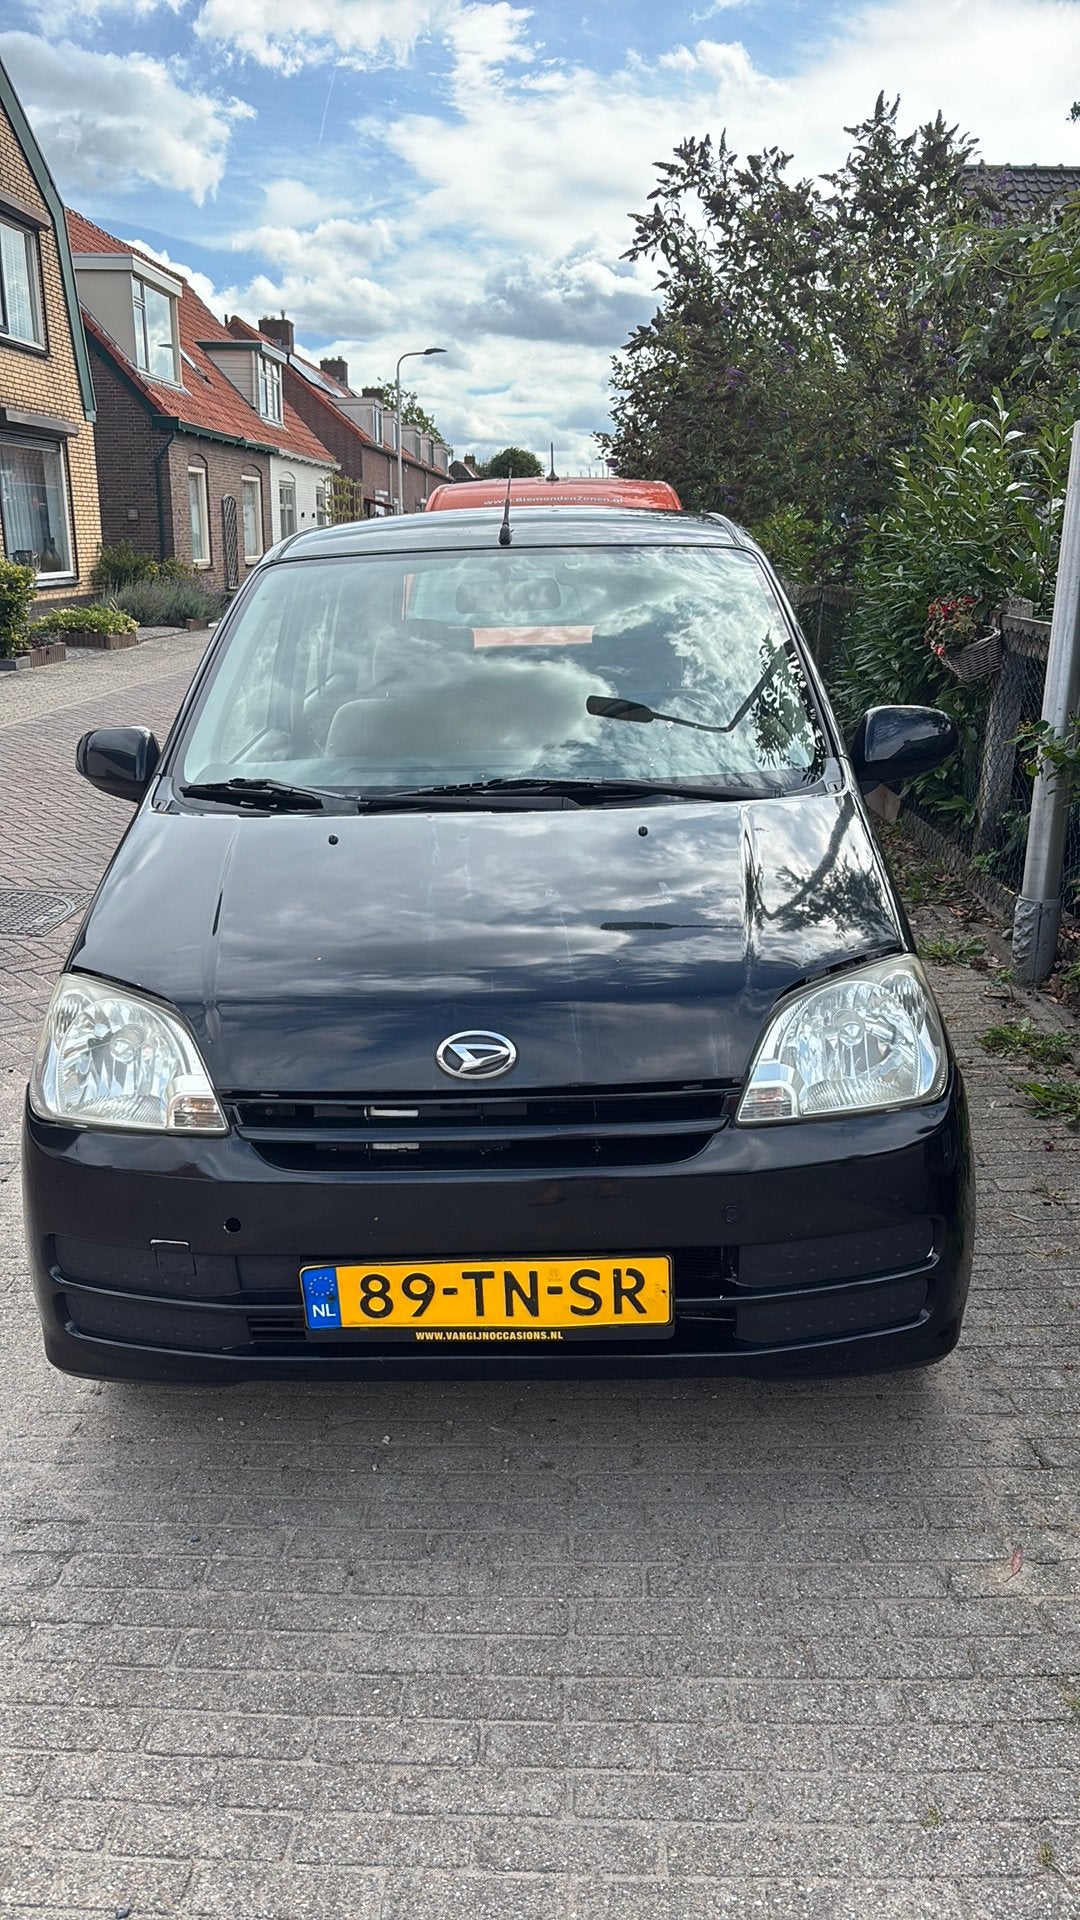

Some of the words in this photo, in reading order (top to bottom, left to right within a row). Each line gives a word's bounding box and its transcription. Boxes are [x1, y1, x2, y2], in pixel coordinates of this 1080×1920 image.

[360, 1268, 647, 1319] 89-TN-SR
[312, 1303, 336, 1318] NL
[415, 1331, 563, 1341] WWW.VANGIJNOCCASIONS.NL
